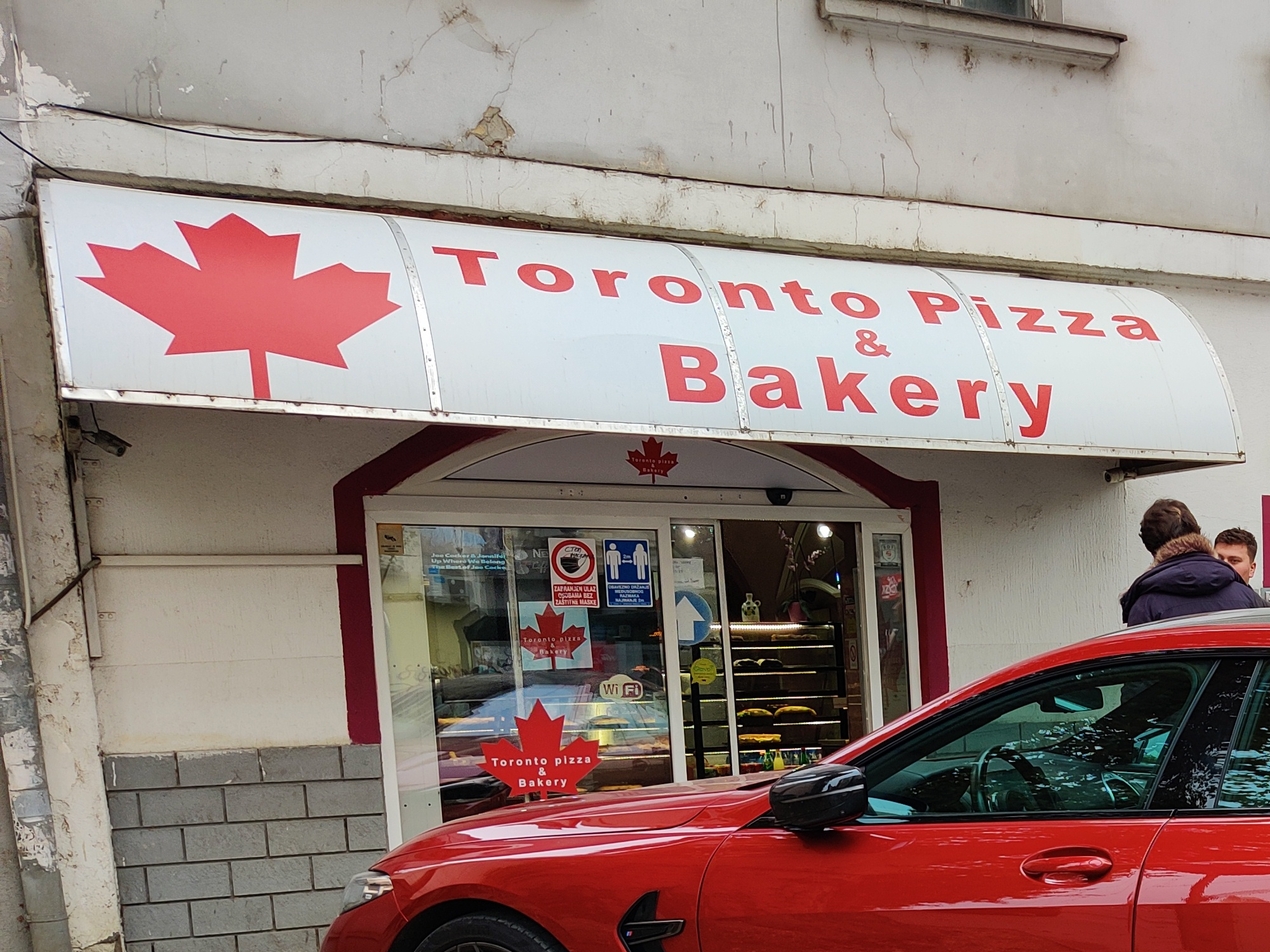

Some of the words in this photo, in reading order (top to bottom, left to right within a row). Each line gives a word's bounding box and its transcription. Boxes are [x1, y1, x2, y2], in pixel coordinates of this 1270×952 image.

[431, 246, 881, 320] Toronto
[907, 290, 1161, 341] Pizza
[854, 329, 891, 357] &
[658, 344, 1053, 438] Bakery
[491, 756, 547, 767] Toronto
[555, 755, 591, 766] pizza
[538, 767, 546, 776] &
[519, 778, 567, 788] Bakery
